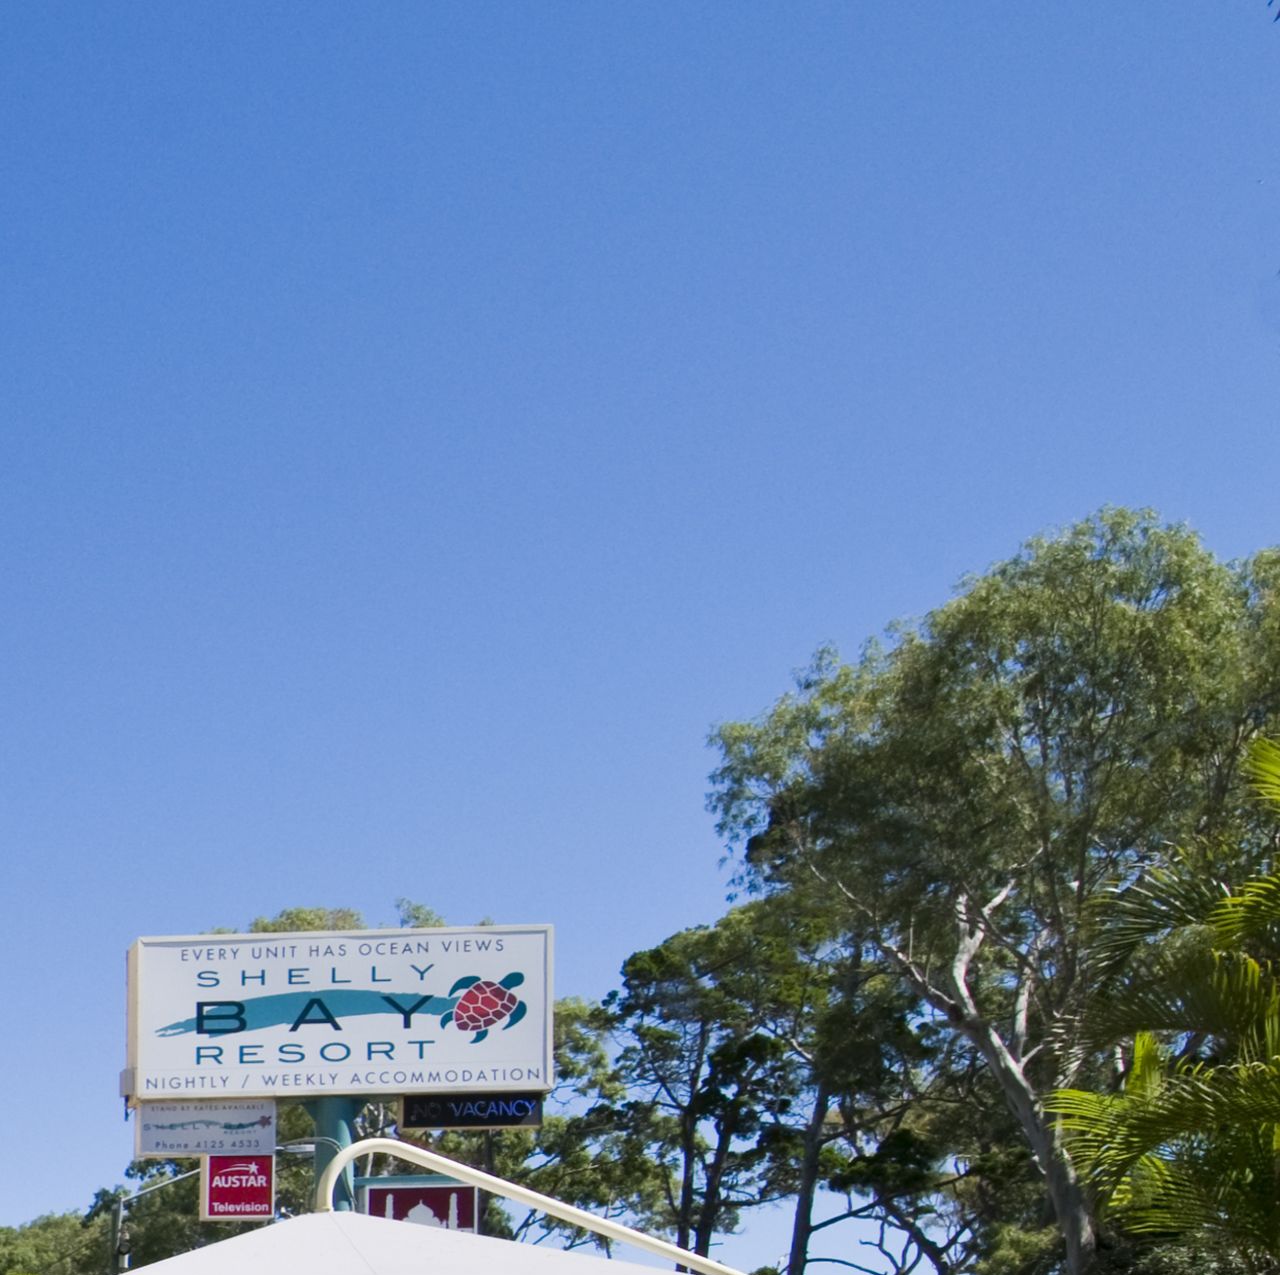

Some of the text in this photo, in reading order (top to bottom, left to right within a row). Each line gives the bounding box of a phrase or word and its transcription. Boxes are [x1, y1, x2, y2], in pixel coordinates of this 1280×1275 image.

[181, 939, 505, 961] EVERY UNIT HAS OCEAN VIEWS
[197, 963, 435, 987] SHELLY
[196, 995, 434, 1035] BAY
[196, 1040, 436, 1065] RESORT
[146, 1076, 230, 1090] NIGHTLY
[262, 1073, 339, 1087] WEEKLY
[350, 1068, 540, 1085] ACCOMMODATION
[222, 1103, 265, 1111] AVAILABLE
[450, 1100, 537, 1119] VACANCY
[155, 1141, 189, 1150] Phone
[195, 1140, 225, 1149] 4125
[212, 1175, 267, 1188] AUSTAR
[212, 1202, 269, 1213] Television
